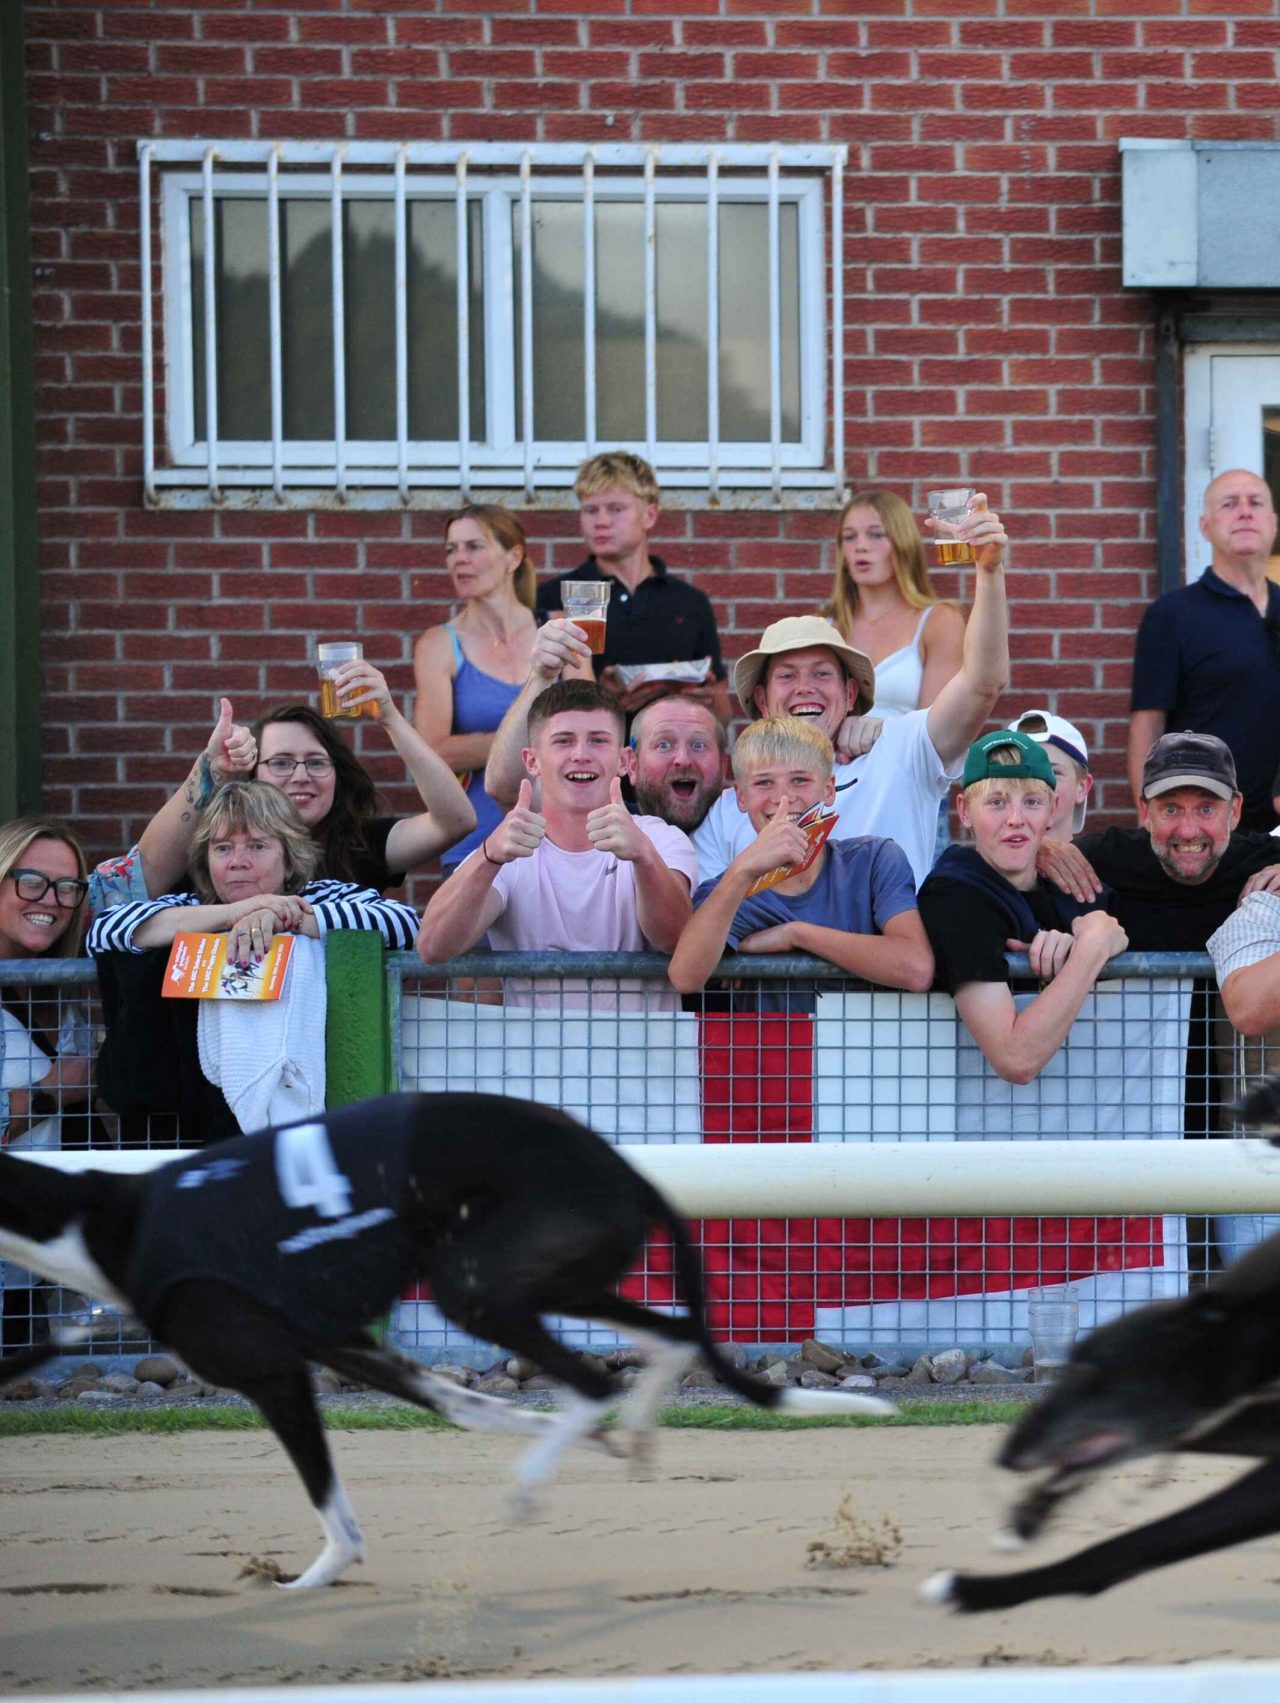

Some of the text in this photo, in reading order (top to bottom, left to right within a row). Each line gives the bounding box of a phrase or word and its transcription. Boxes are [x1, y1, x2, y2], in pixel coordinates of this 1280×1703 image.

[188, 982, 196, 992] The
[197, 938, 206, 955] Stakes
[207, 955, 216, 970] Puppy
[275, 1123, 353, 1218] 4
